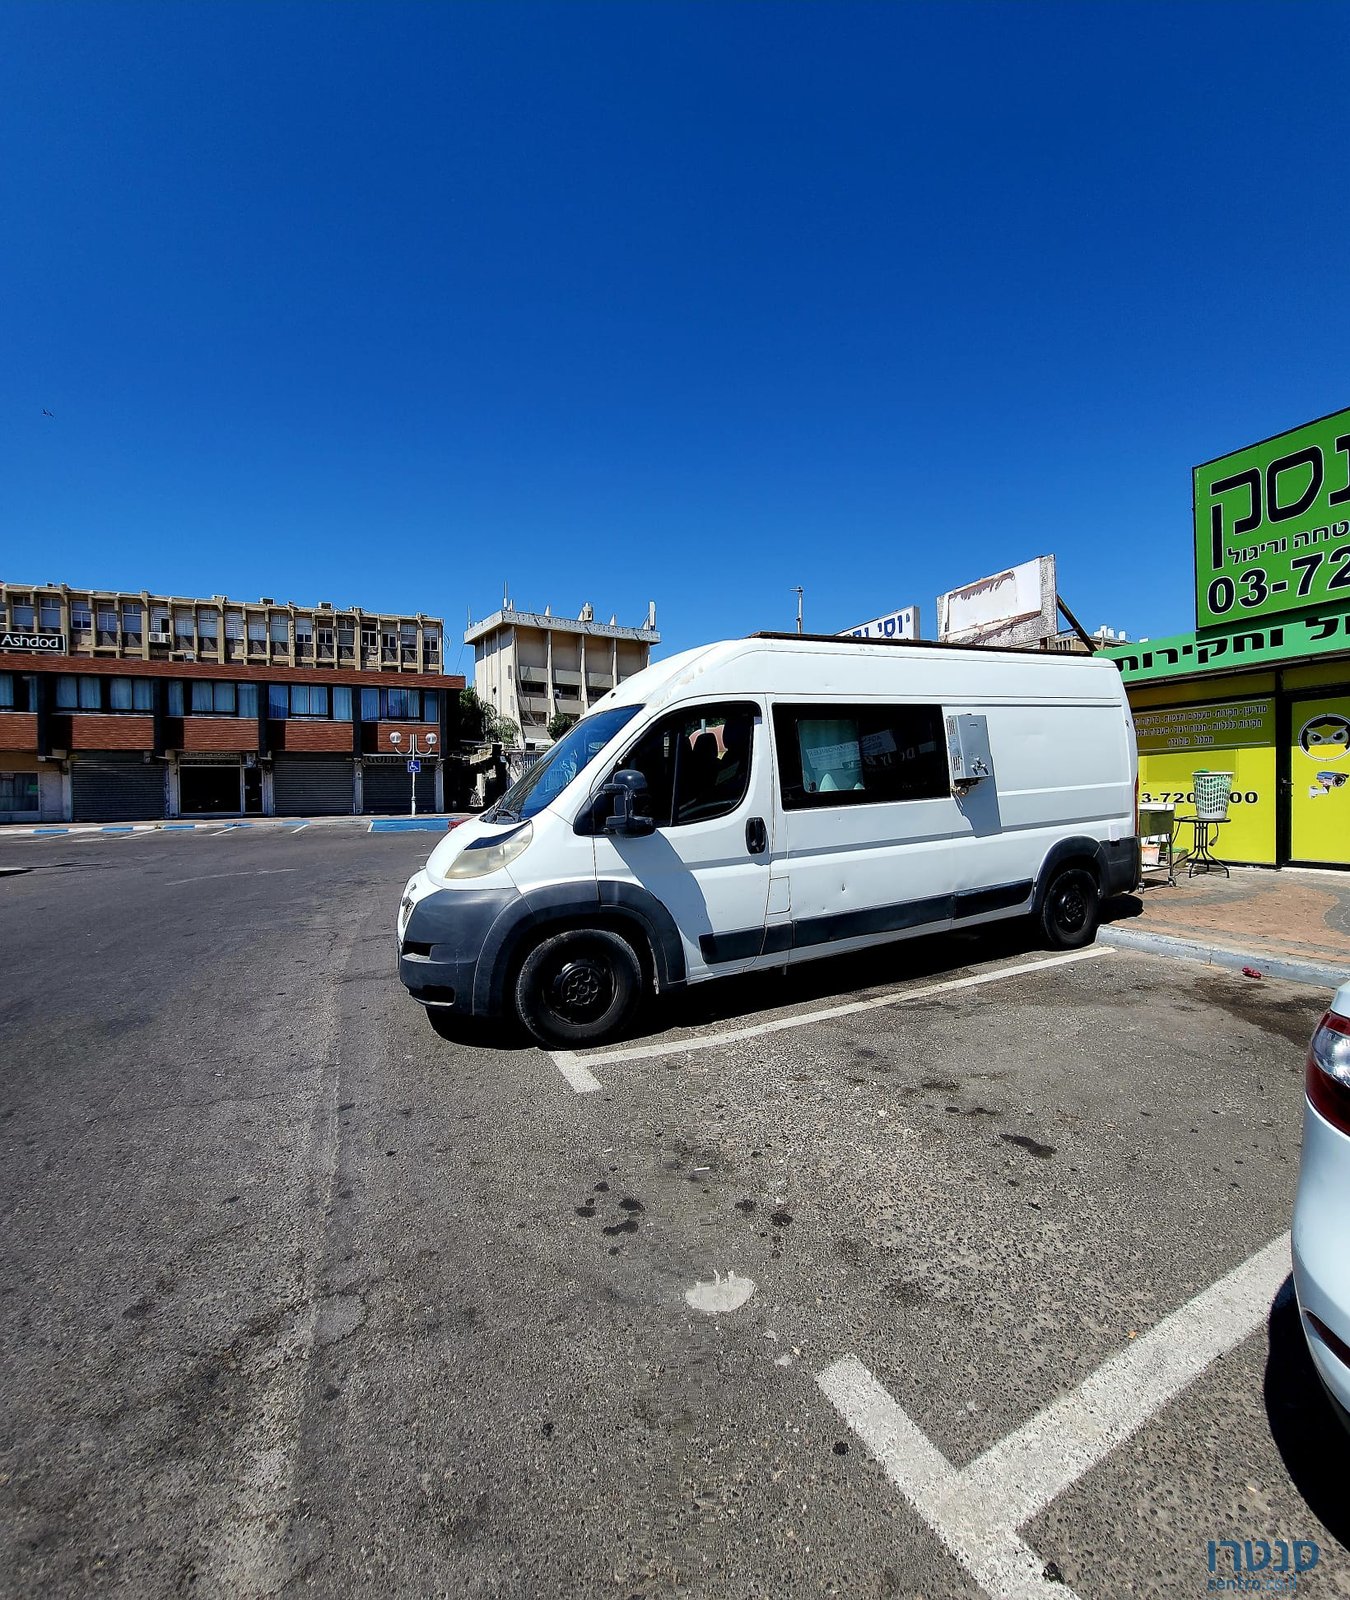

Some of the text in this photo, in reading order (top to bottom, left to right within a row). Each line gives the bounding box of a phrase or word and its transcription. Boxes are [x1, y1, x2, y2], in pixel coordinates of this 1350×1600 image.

[1226, 536, 1288, 565] וריגול
[1, 634, 59, 649] Ashdod
[1111, 627, 1284, 673] וחקירות
